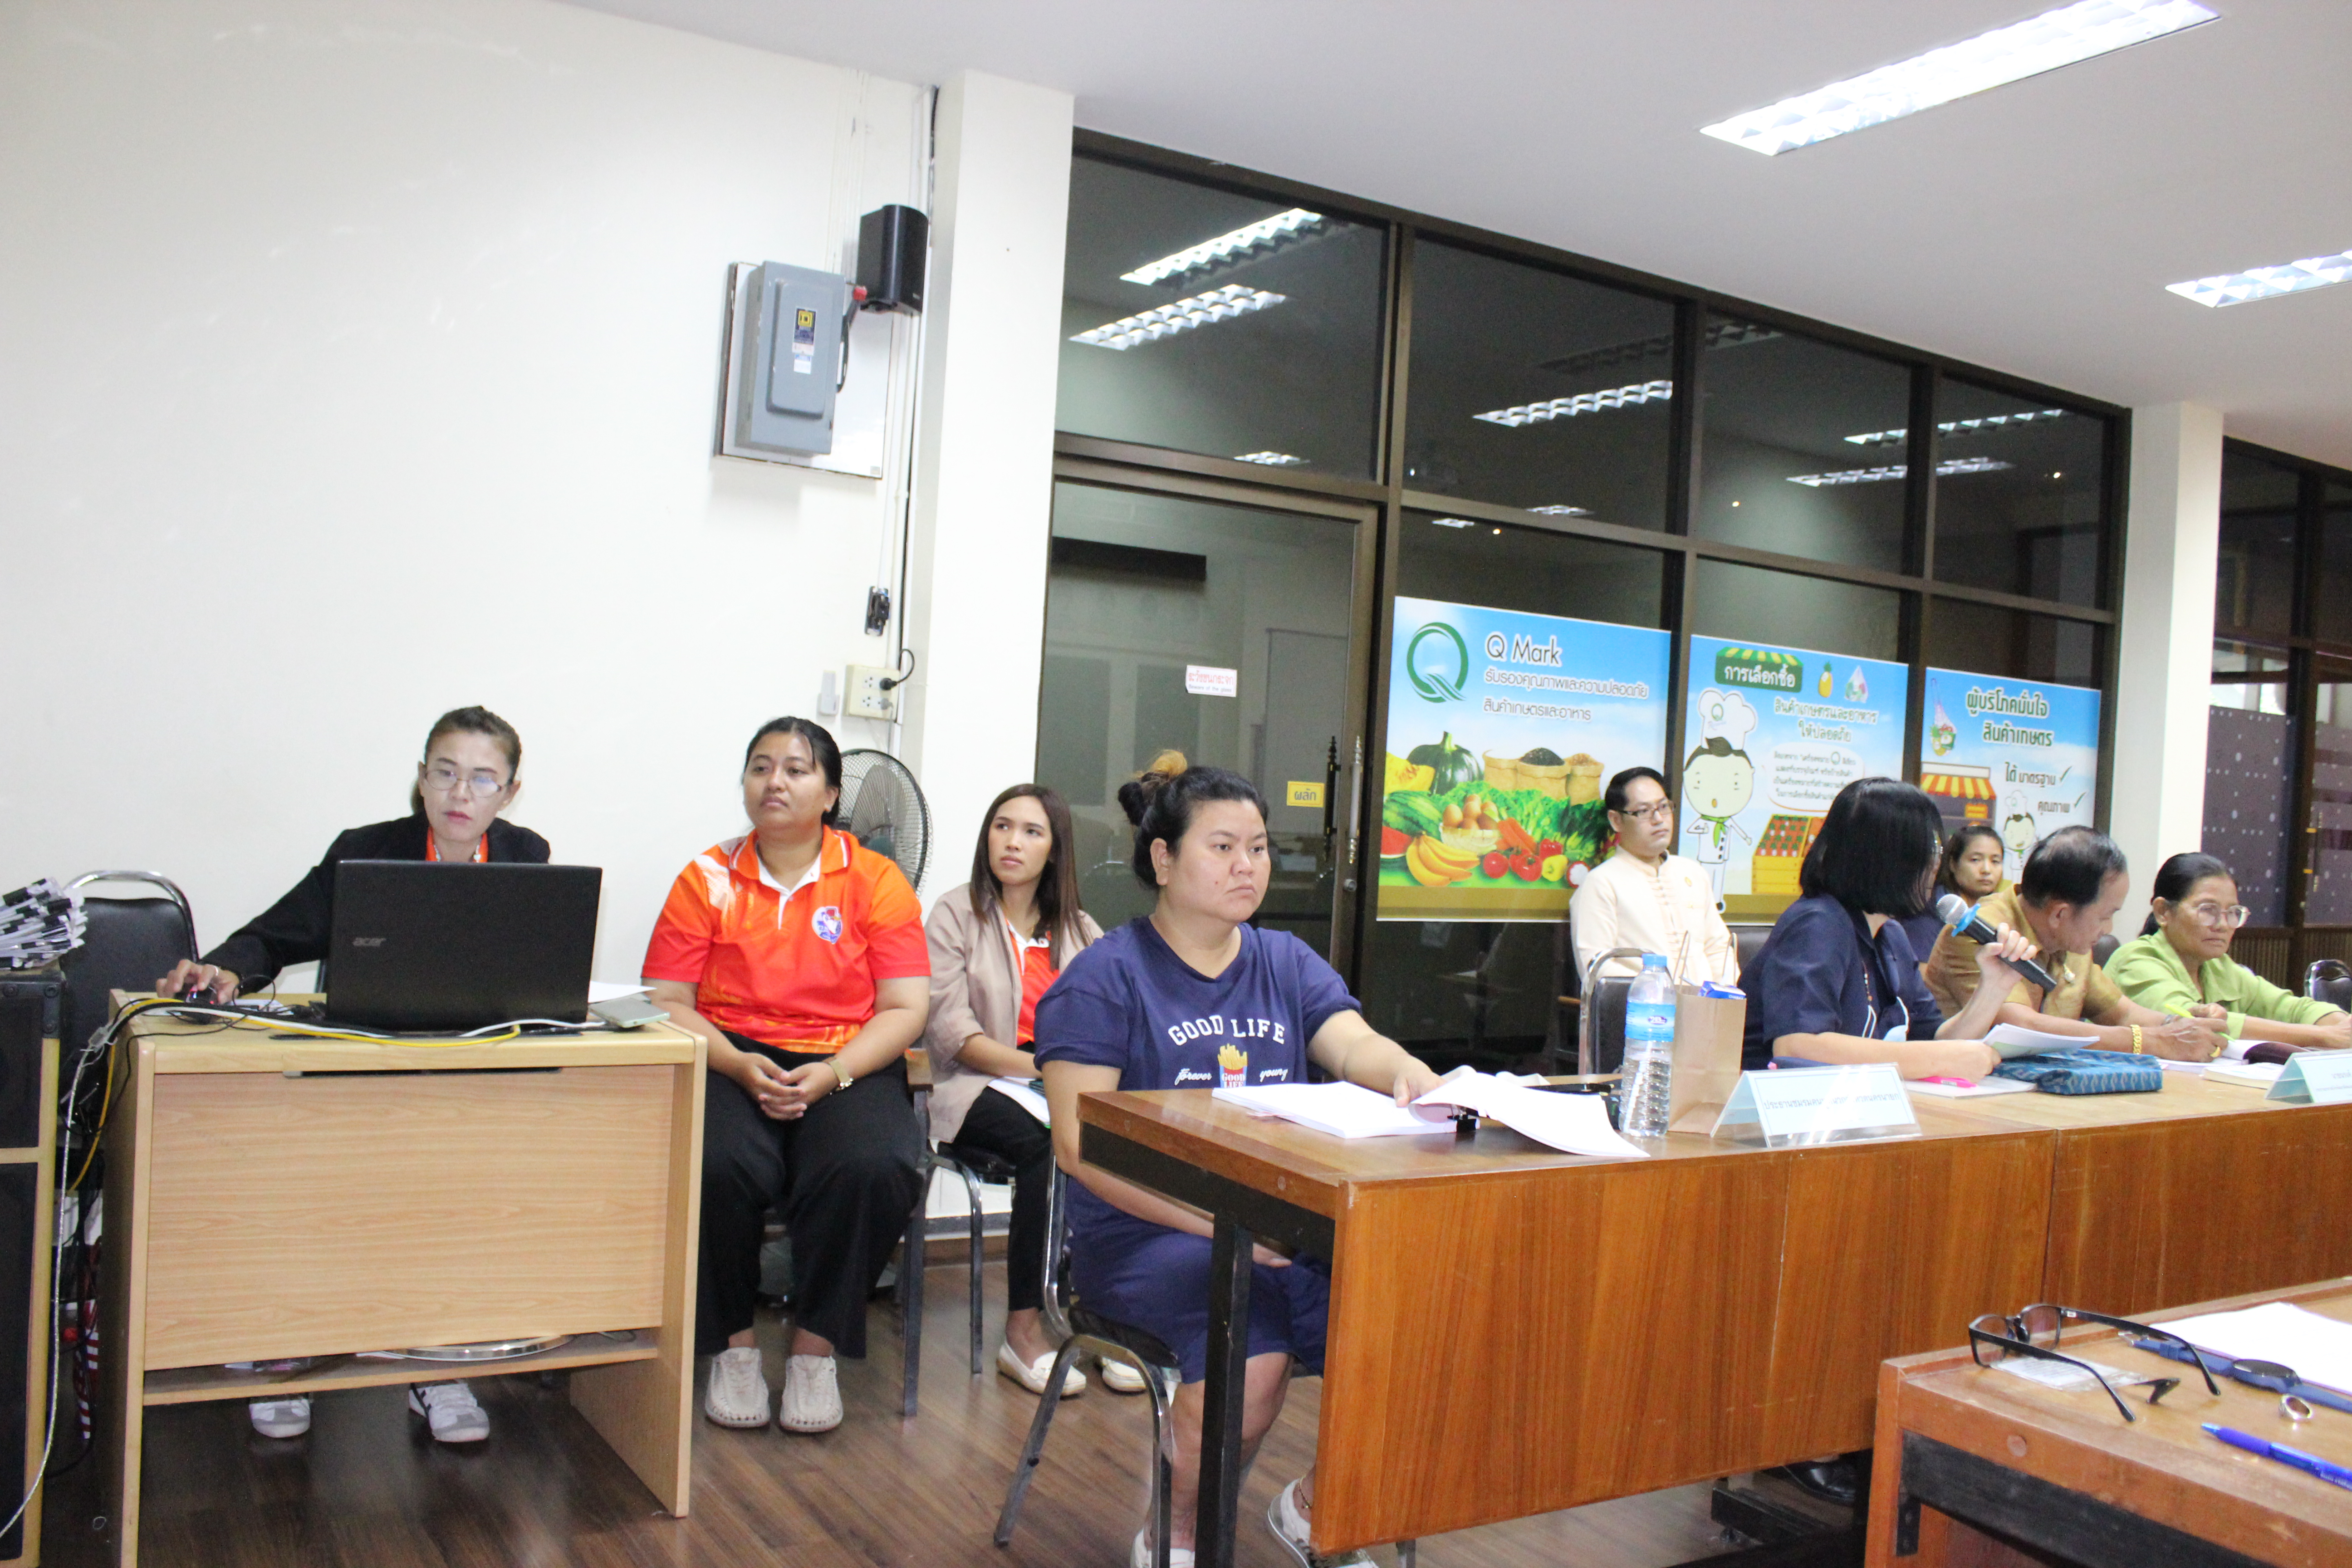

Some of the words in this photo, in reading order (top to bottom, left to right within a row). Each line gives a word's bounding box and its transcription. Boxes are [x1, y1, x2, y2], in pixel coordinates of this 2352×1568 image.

[1487, 634, 1505, 659] Q
[1513, 637, 1560, 665] Mark
[1485, 668, 1648, 698] รับรองคุณภาพและความปลอดภัย
[1725, 663, 1796, 687] การเลือกซื้อ
[1483, 697, 1592, 721] สินค้าเกษตรและอาหาร
[1966, 688, 2049, 716] ผู้บริโภคมั่นใจ
[1798, 720, 1852, 742] ให้ปลอดภัย
[1983, 722, 2053, 746] สินค้าเกษตร
[2005, 761, 2017, 782] ได้
[2019, 773, 2056, 788] มาตรฐาน
[1294, 788, 1316, 801] ผลัก
[353, 937, 386, 947] acer
[1168, 1014, 1224, 1046] GOOD
[1230, 1018, 1285, 1045] LIFE
[1221, 1073, 1246, 1082] GOOD
[1259, 1068, 1288, 1083] young
